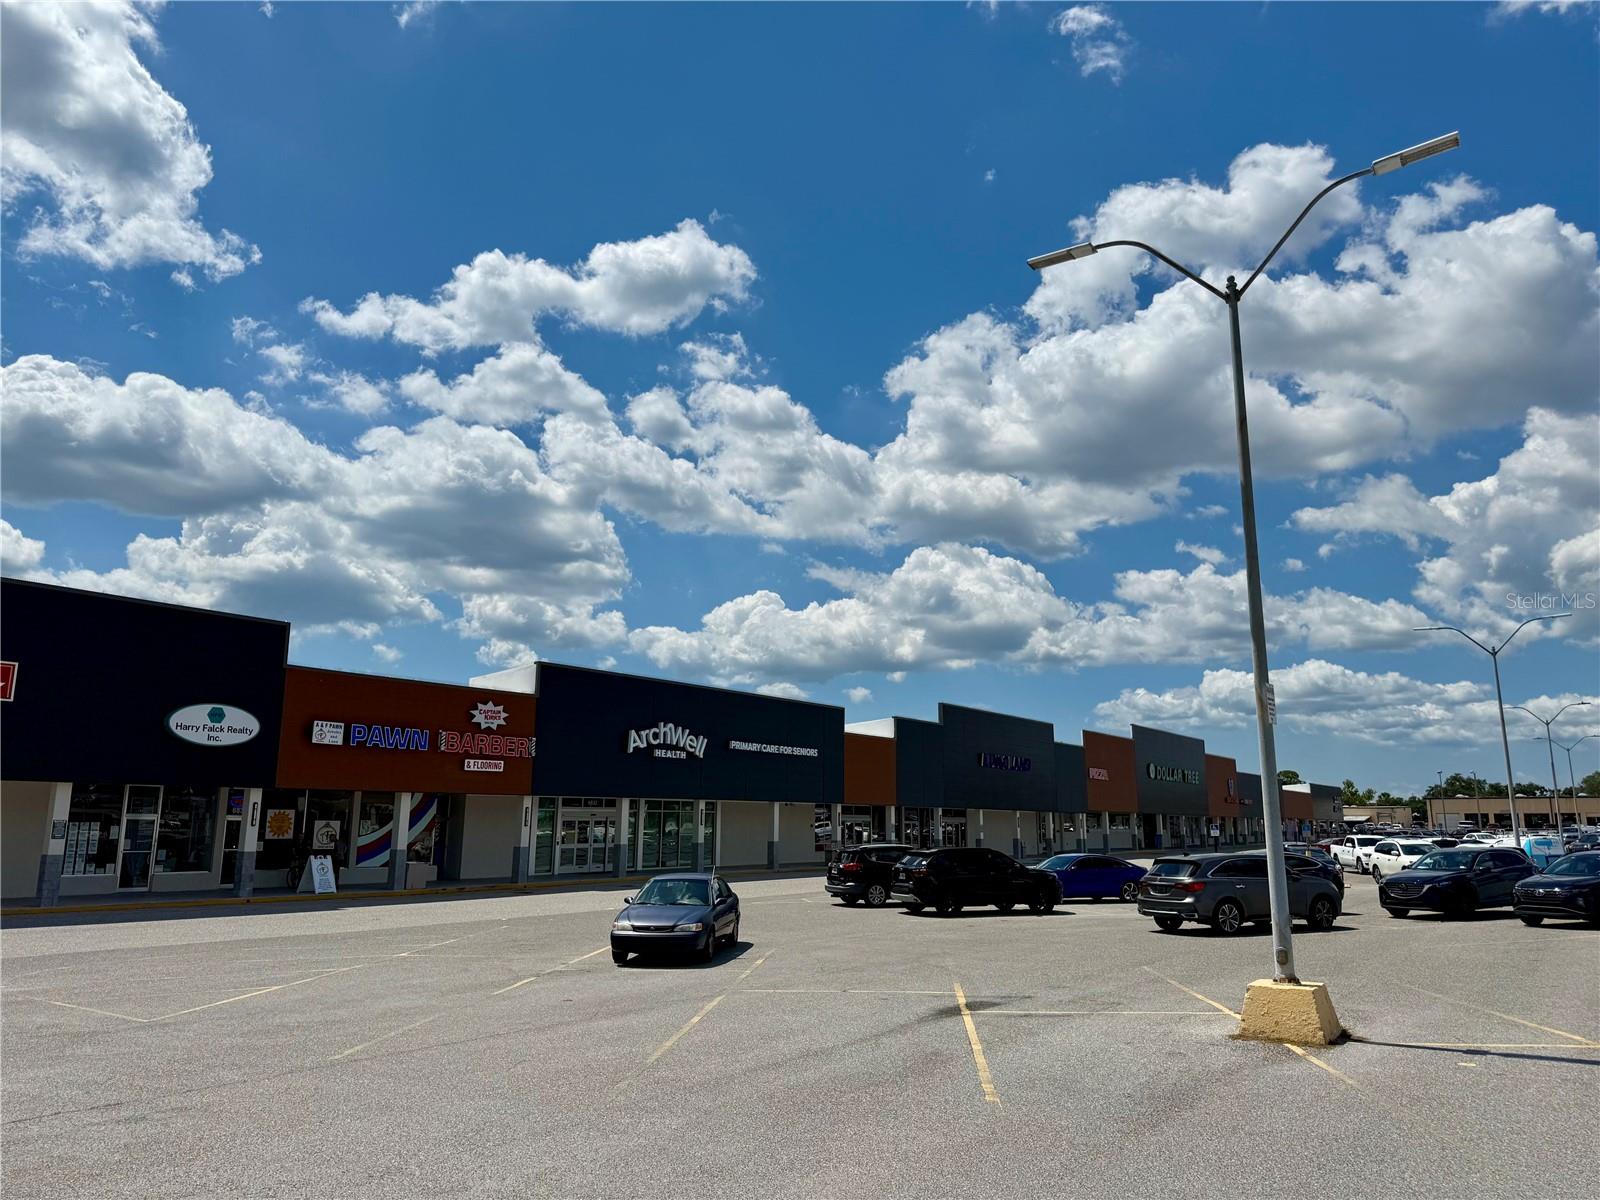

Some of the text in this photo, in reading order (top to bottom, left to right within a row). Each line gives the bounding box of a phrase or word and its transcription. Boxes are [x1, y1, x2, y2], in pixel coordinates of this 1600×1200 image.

[175, 722, 254, 736] Harry Falck Realty
[350, 723, 430, 751] PAWN
[207, 734, 222, 742] Inc.
[445, 731, 529, 758] BARBER
[627, 721, 708, 759] ArchWell
[653, 749, 687, 759] HEALTH
[729, 740, 819, 757] PRIMARY CARE FOR SENIORS
[466, 761, 502, 770] & FLOORING
[1156, 766, 1200, 785] DOLLAR TREE
